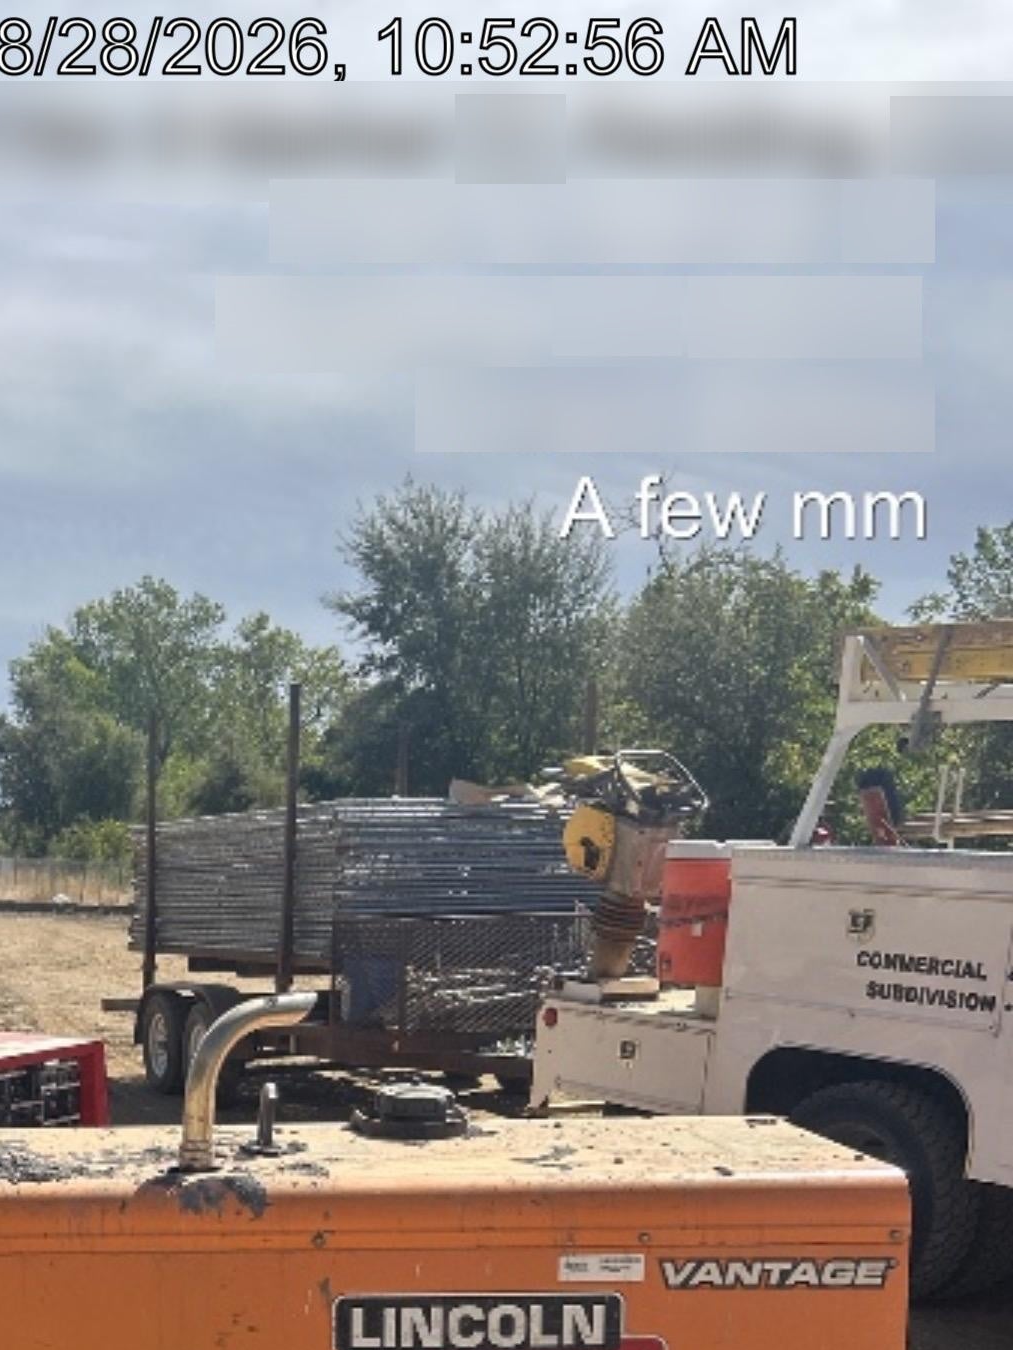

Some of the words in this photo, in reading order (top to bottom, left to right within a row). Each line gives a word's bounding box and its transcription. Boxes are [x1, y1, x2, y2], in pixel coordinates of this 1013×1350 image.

[857, 951, 988, 982] COMMERCIAL
[866, 981, 997, 1012] SUBDIVISION
[661, 1259, 890, 1287] VANTAGE
[351, 1304, 606, 1349] LINCOLN
